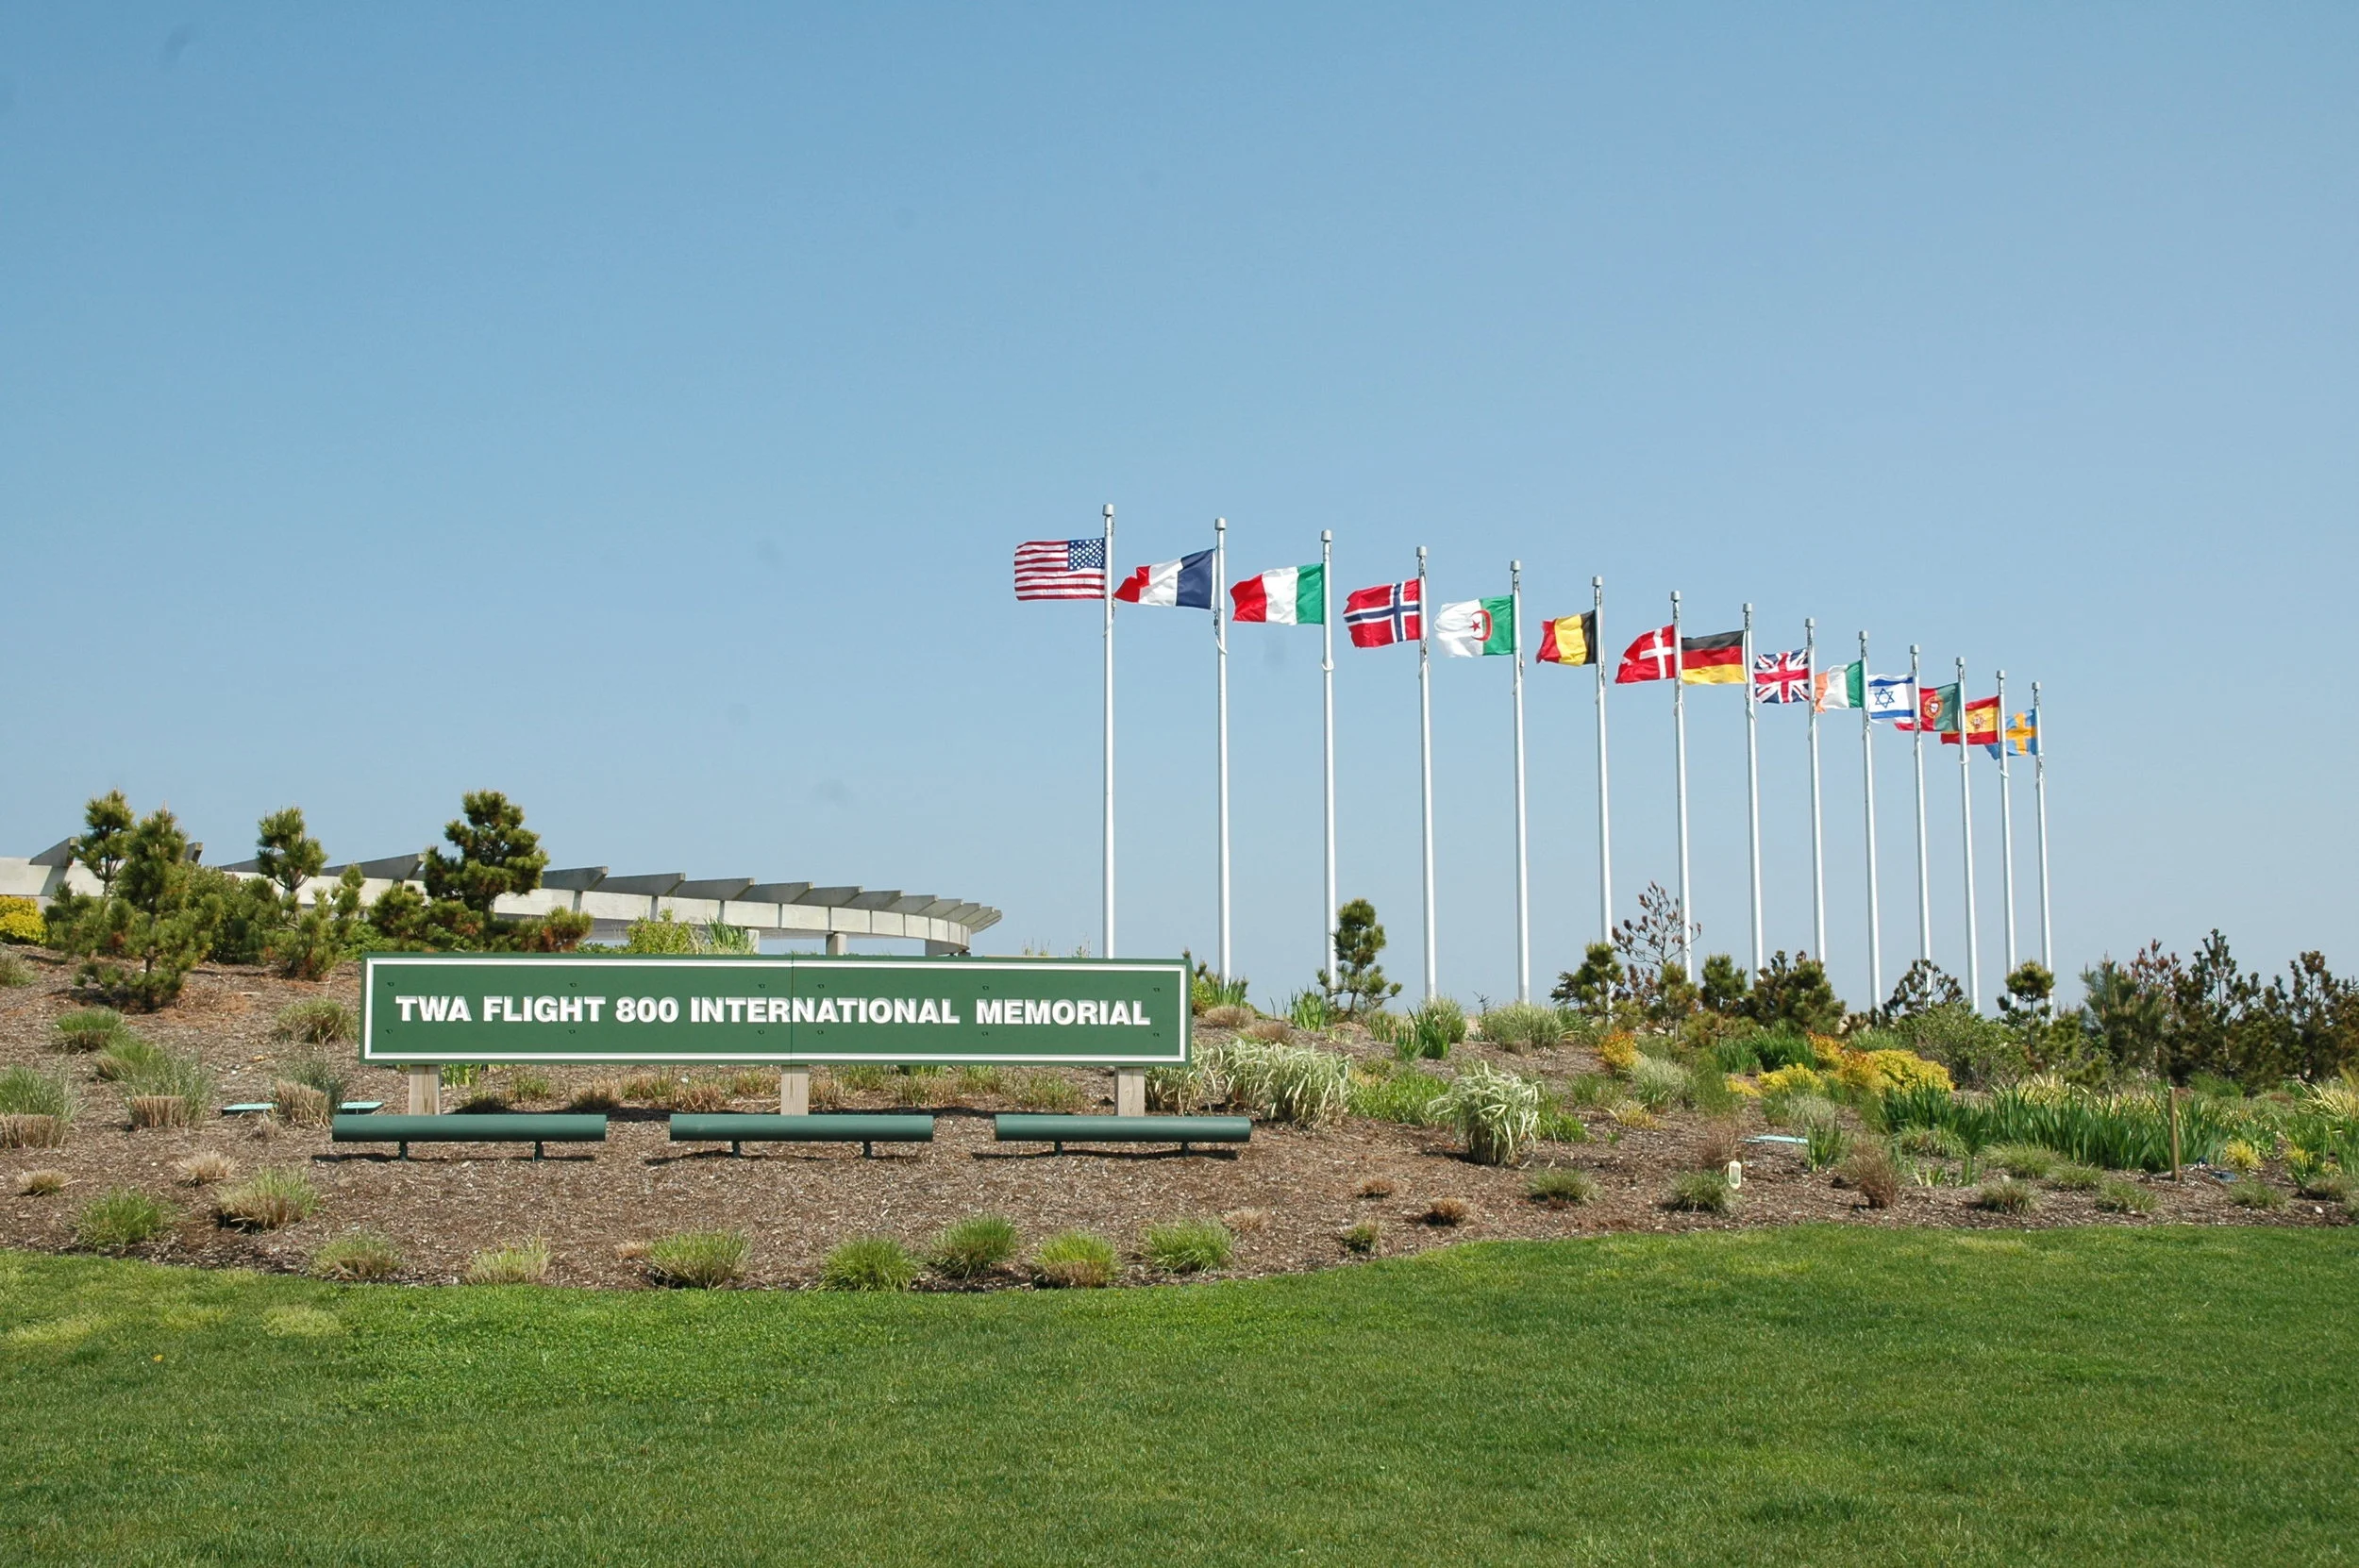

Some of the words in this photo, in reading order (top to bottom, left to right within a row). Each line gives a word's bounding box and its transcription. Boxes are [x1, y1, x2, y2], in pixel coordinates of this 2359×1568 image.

[394, 995, 473, 1023] TWA
[483, 995, 607, 1024] FLIGHT
[615, 996, 680, 1024] 800
[690, 996, 961, 1025] INTERNATIONAL
[976, 998, 1152, 1026] MEMORIAL
